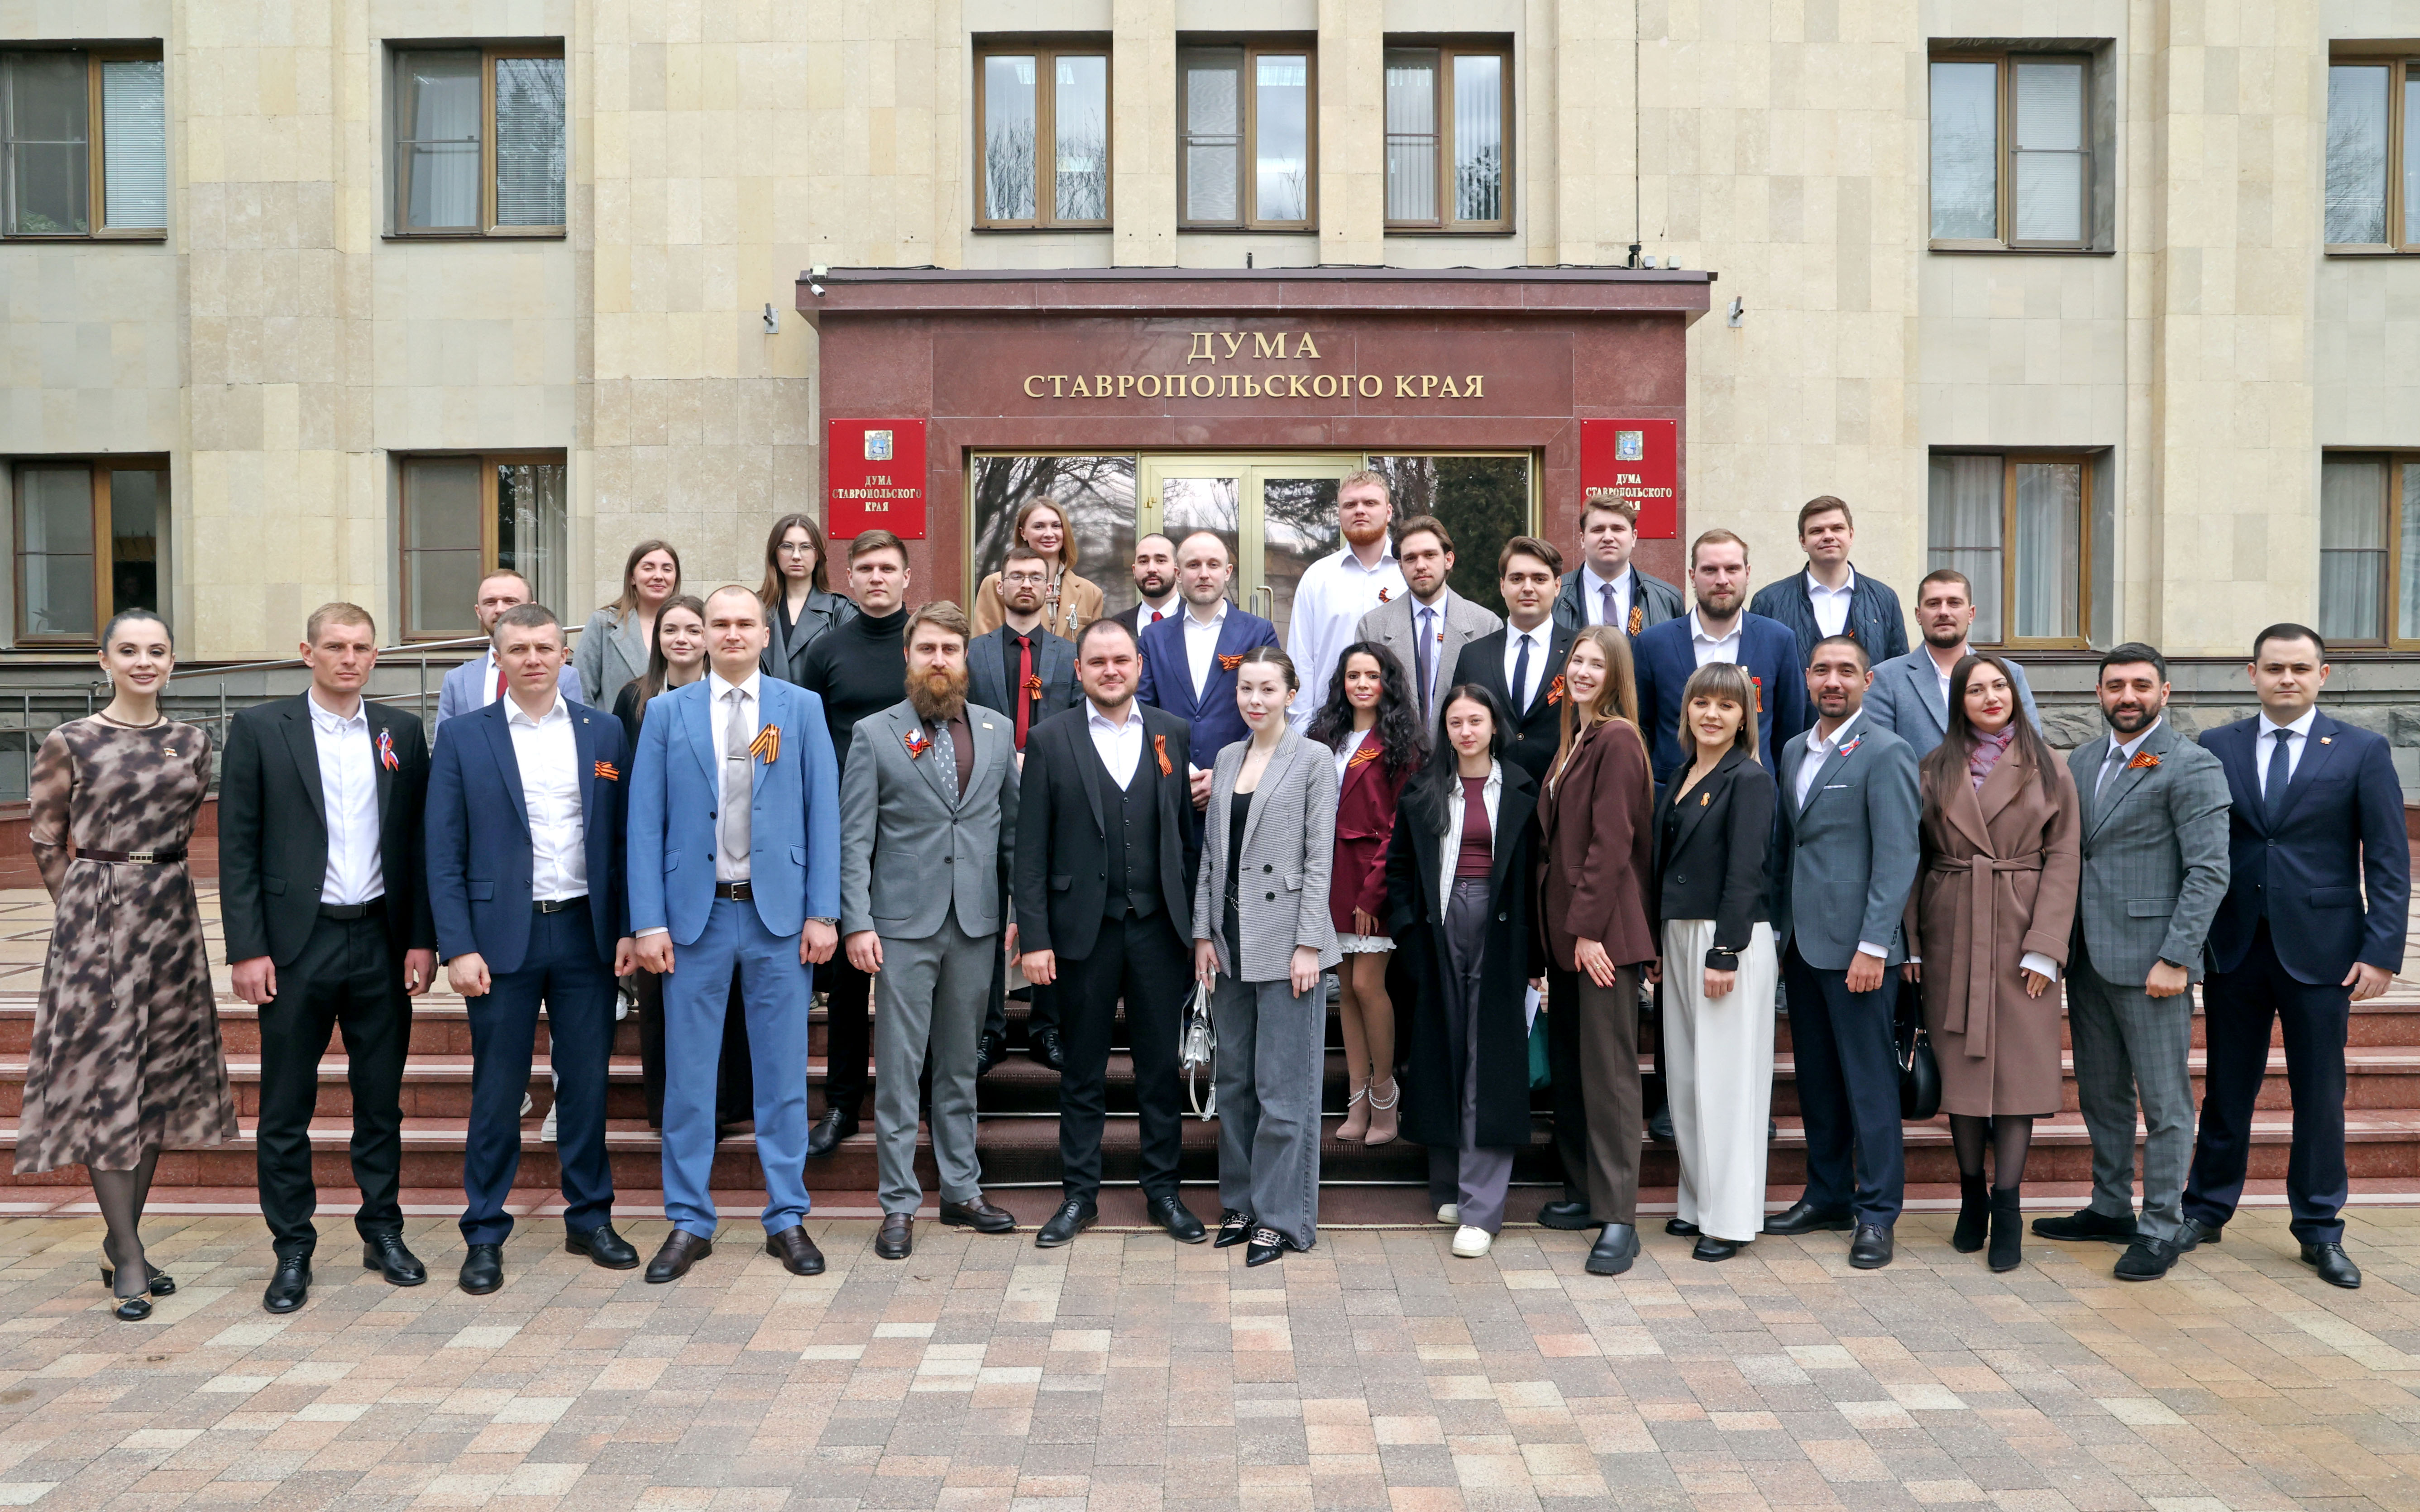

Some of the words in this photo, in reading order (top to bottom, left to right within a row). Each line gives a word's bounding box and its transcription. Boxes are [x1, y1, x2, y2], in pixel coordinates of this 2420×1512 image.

[1187, 332, 1321, 365] ДУМА
[1023, 374, 1382, 398] СТАВРОПОЛЬСКОГО
[1394, 375, 1484, 398] КРАЯ
[865, 475, 892, 487] ДУМА
[1616, 474, 1641, 486] ДУМА
[832, 488, 922, 498] СТАВРОПОЛЬСКОГО
[1585, 487, 1673, 498] СТАВРОПОЛЬСКОГО
[865, 502, 889, 512] КРАЯ
